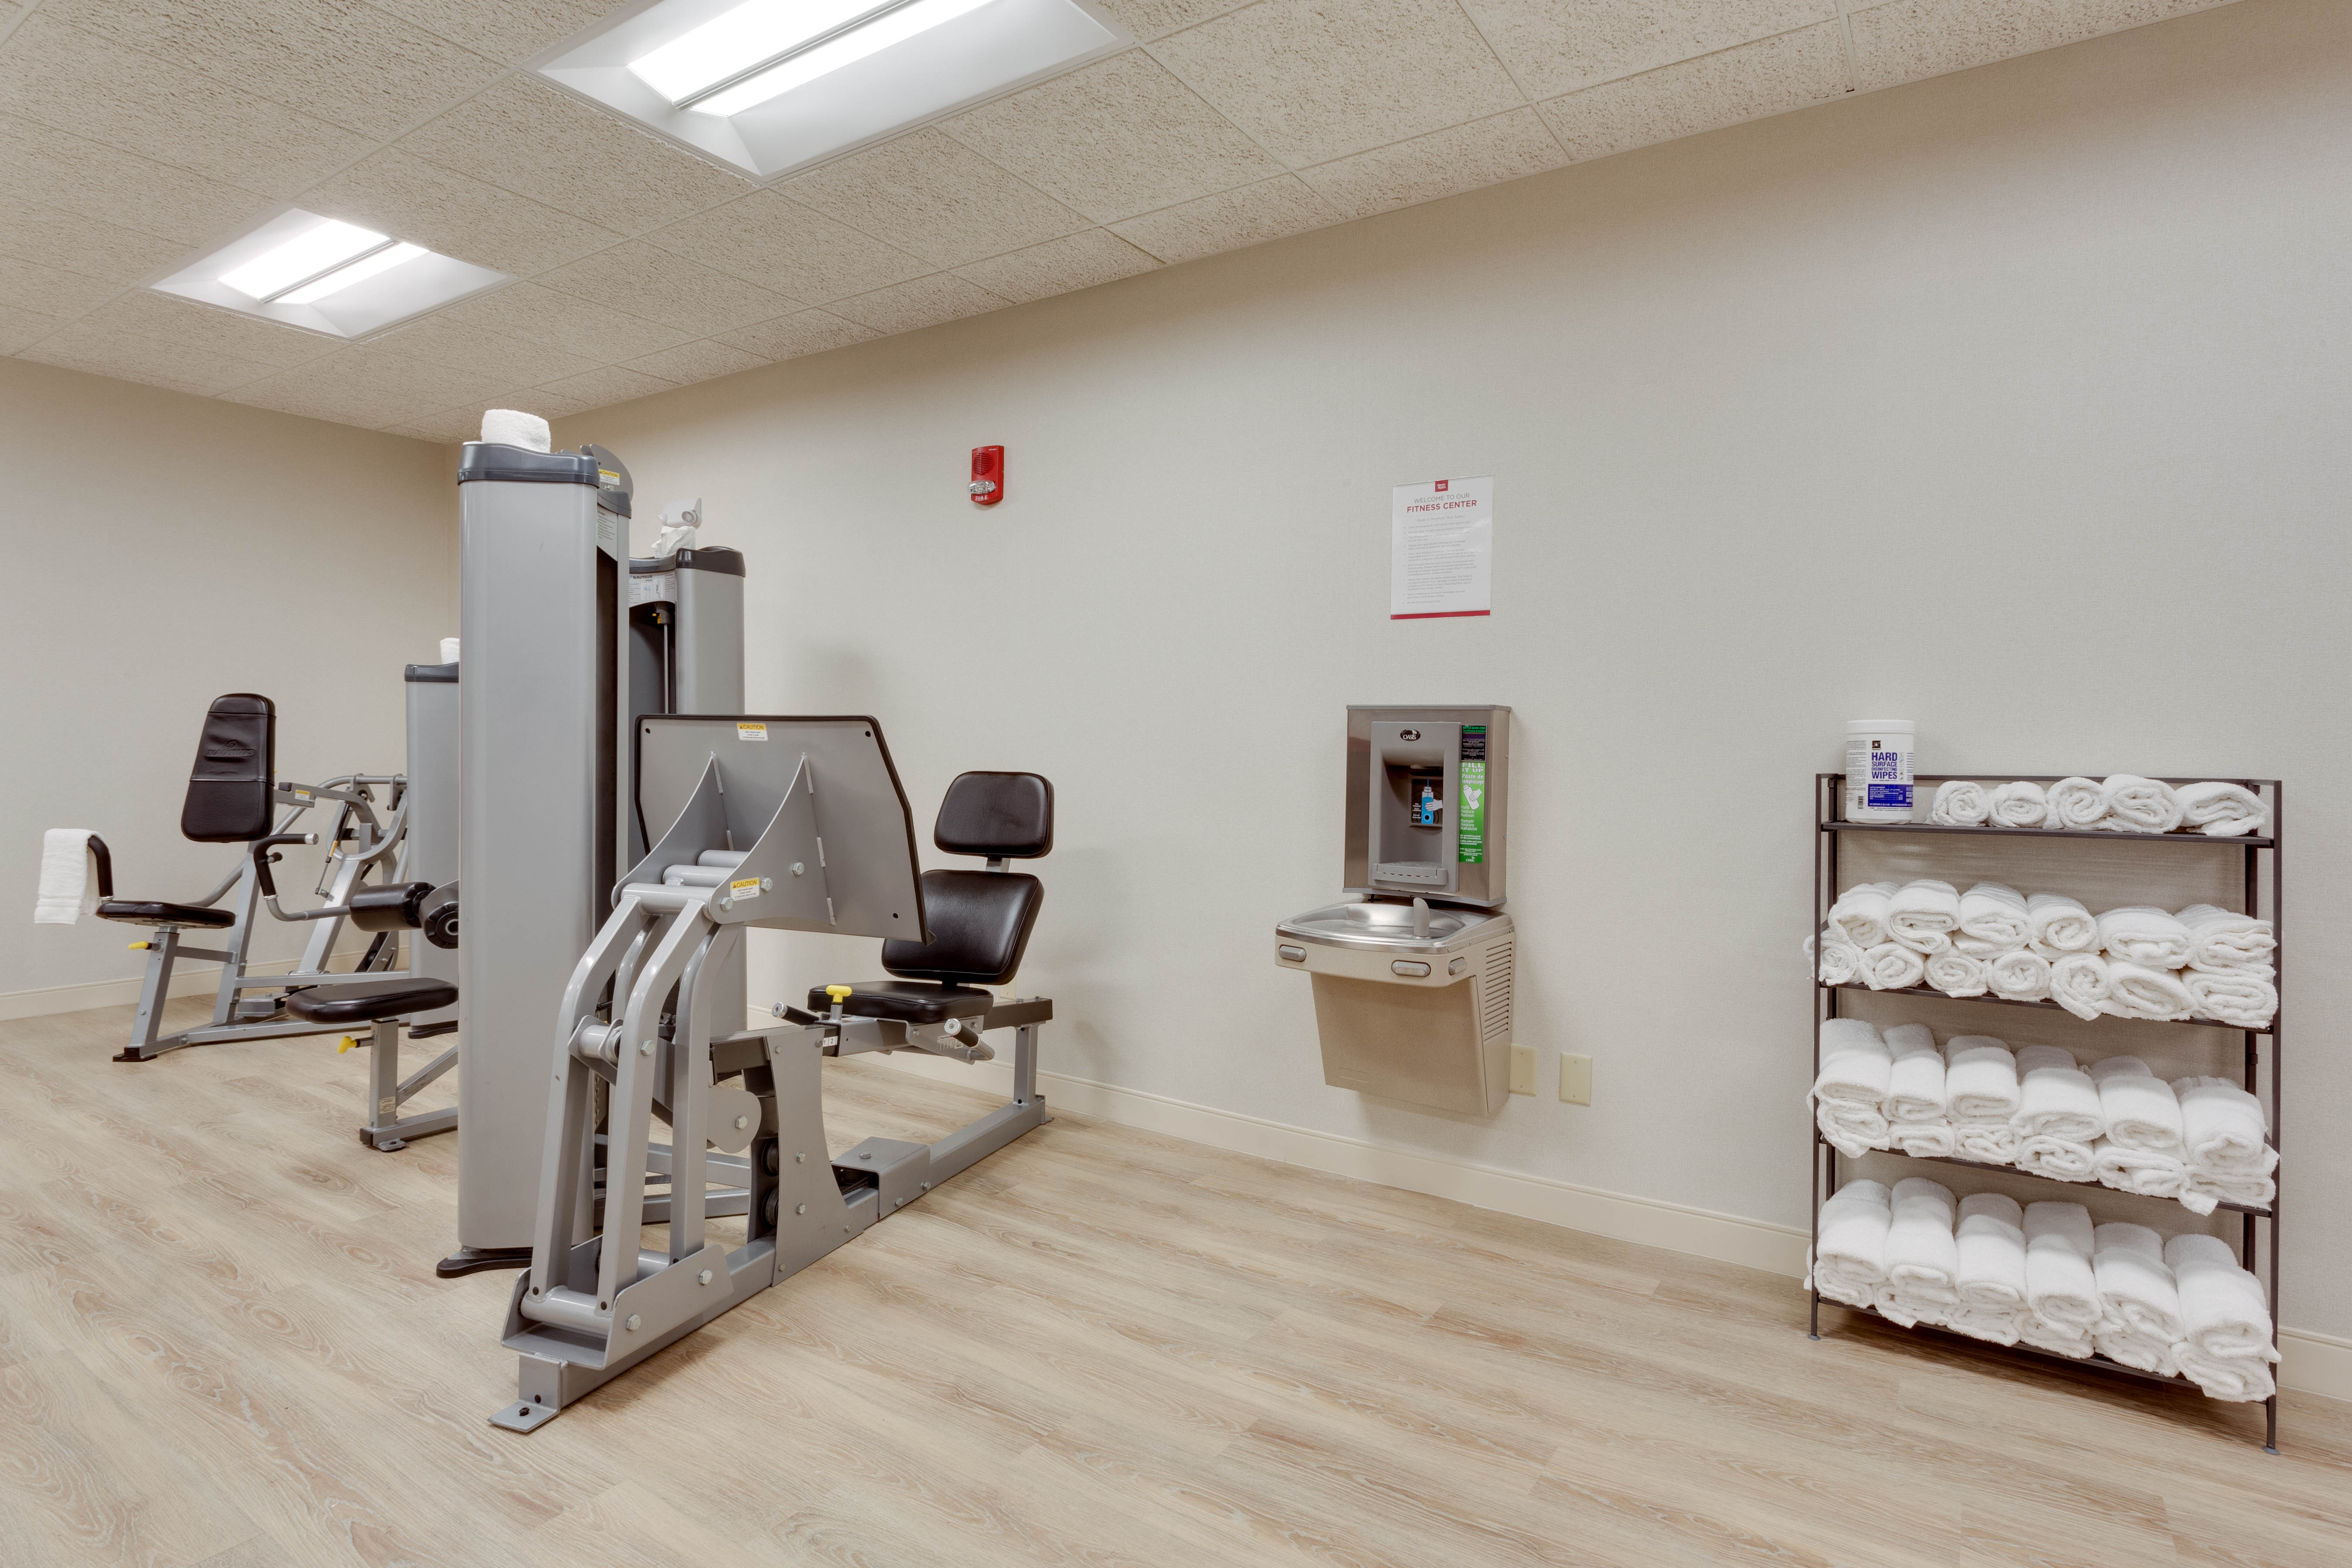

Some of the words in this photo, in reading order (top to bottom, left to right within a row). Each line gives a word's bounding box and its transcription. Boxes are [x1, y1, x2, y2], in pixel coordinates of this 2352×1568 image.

[1407, 503, 1440, 512] FITNESS
[1443, 500, 1477, 509] CENTER
[1872, 752, 1897, 761] HARD
